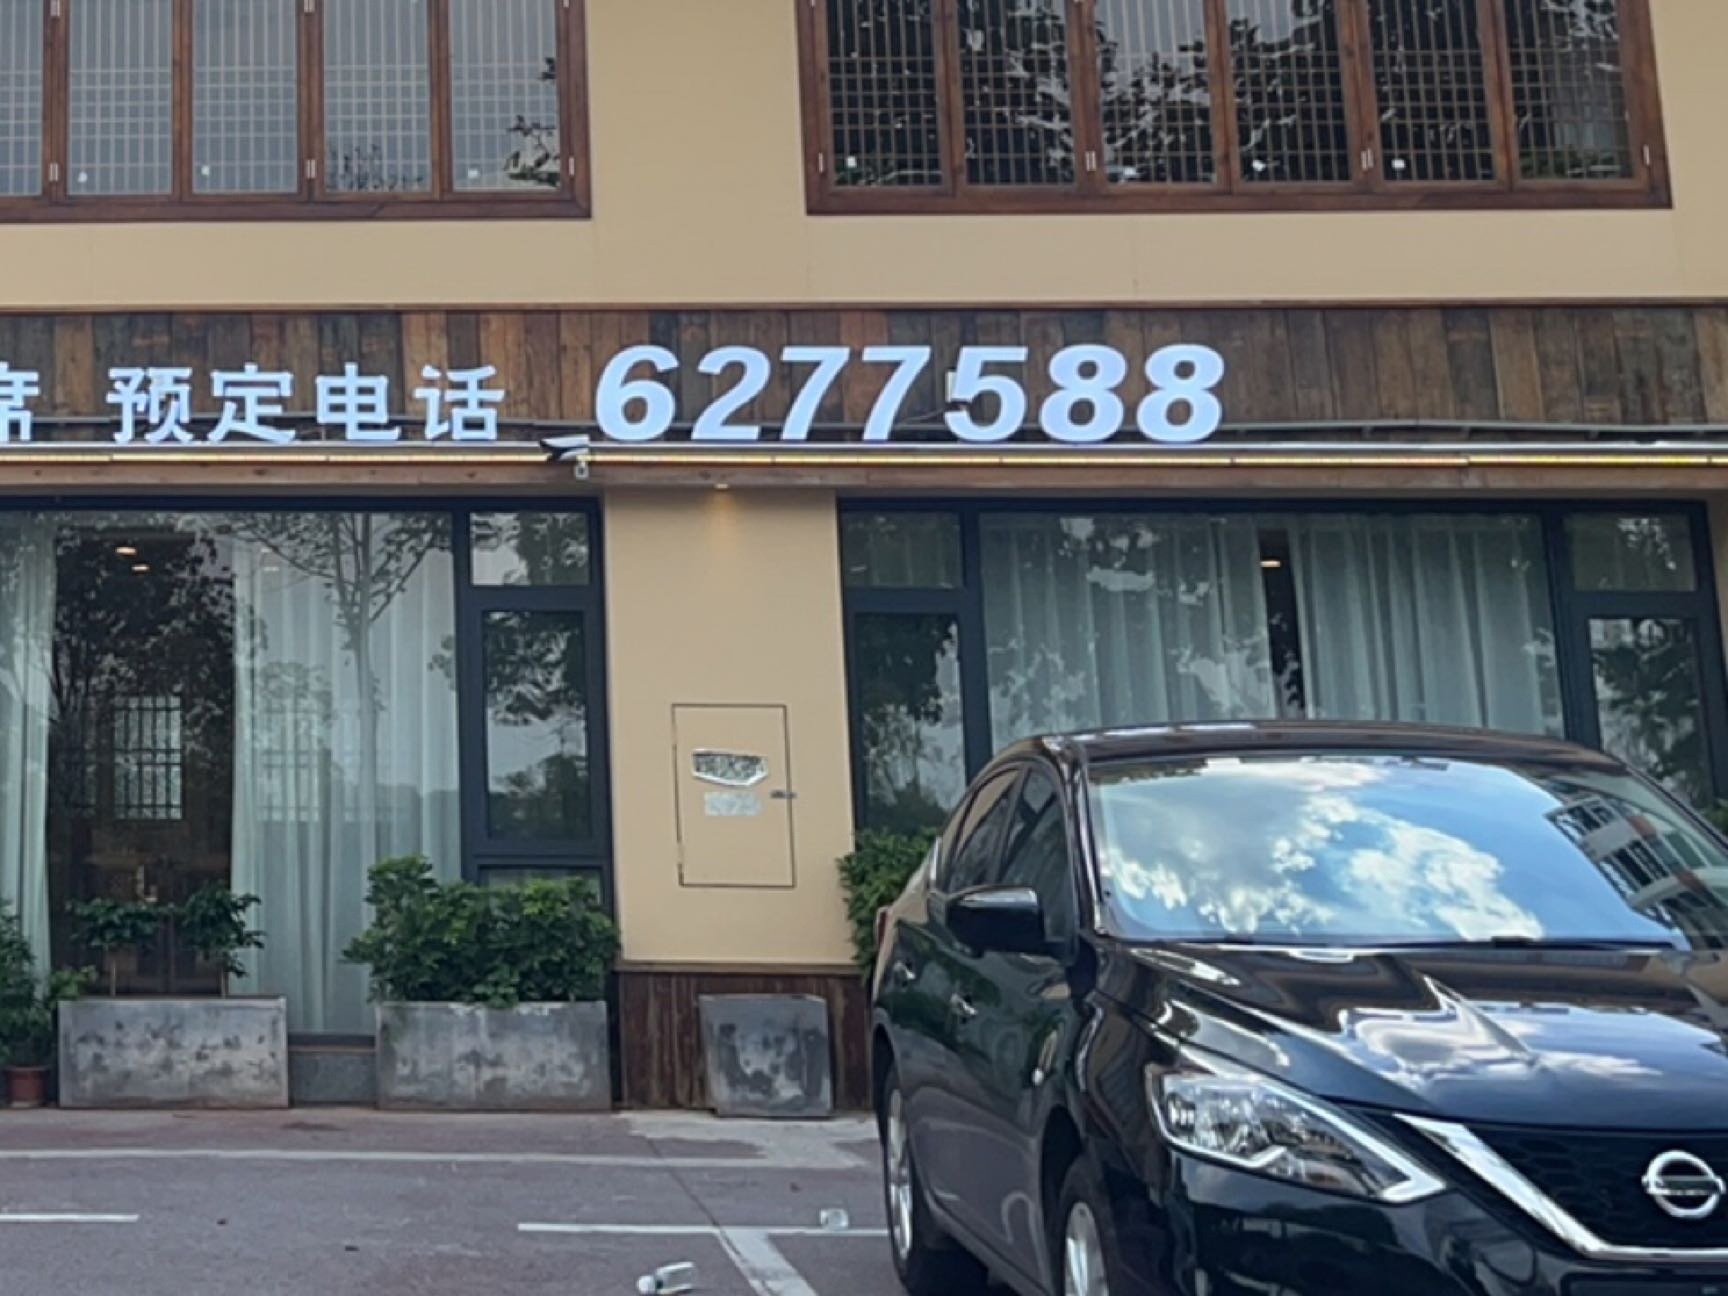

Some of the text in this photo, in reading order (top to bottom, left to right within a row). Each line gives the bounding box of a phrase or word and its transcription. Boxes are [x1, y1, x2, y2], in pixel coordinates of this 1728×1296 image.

[106, 362, 506, 444] 预定电话
[594, 344, 1226, 441] 6277588
